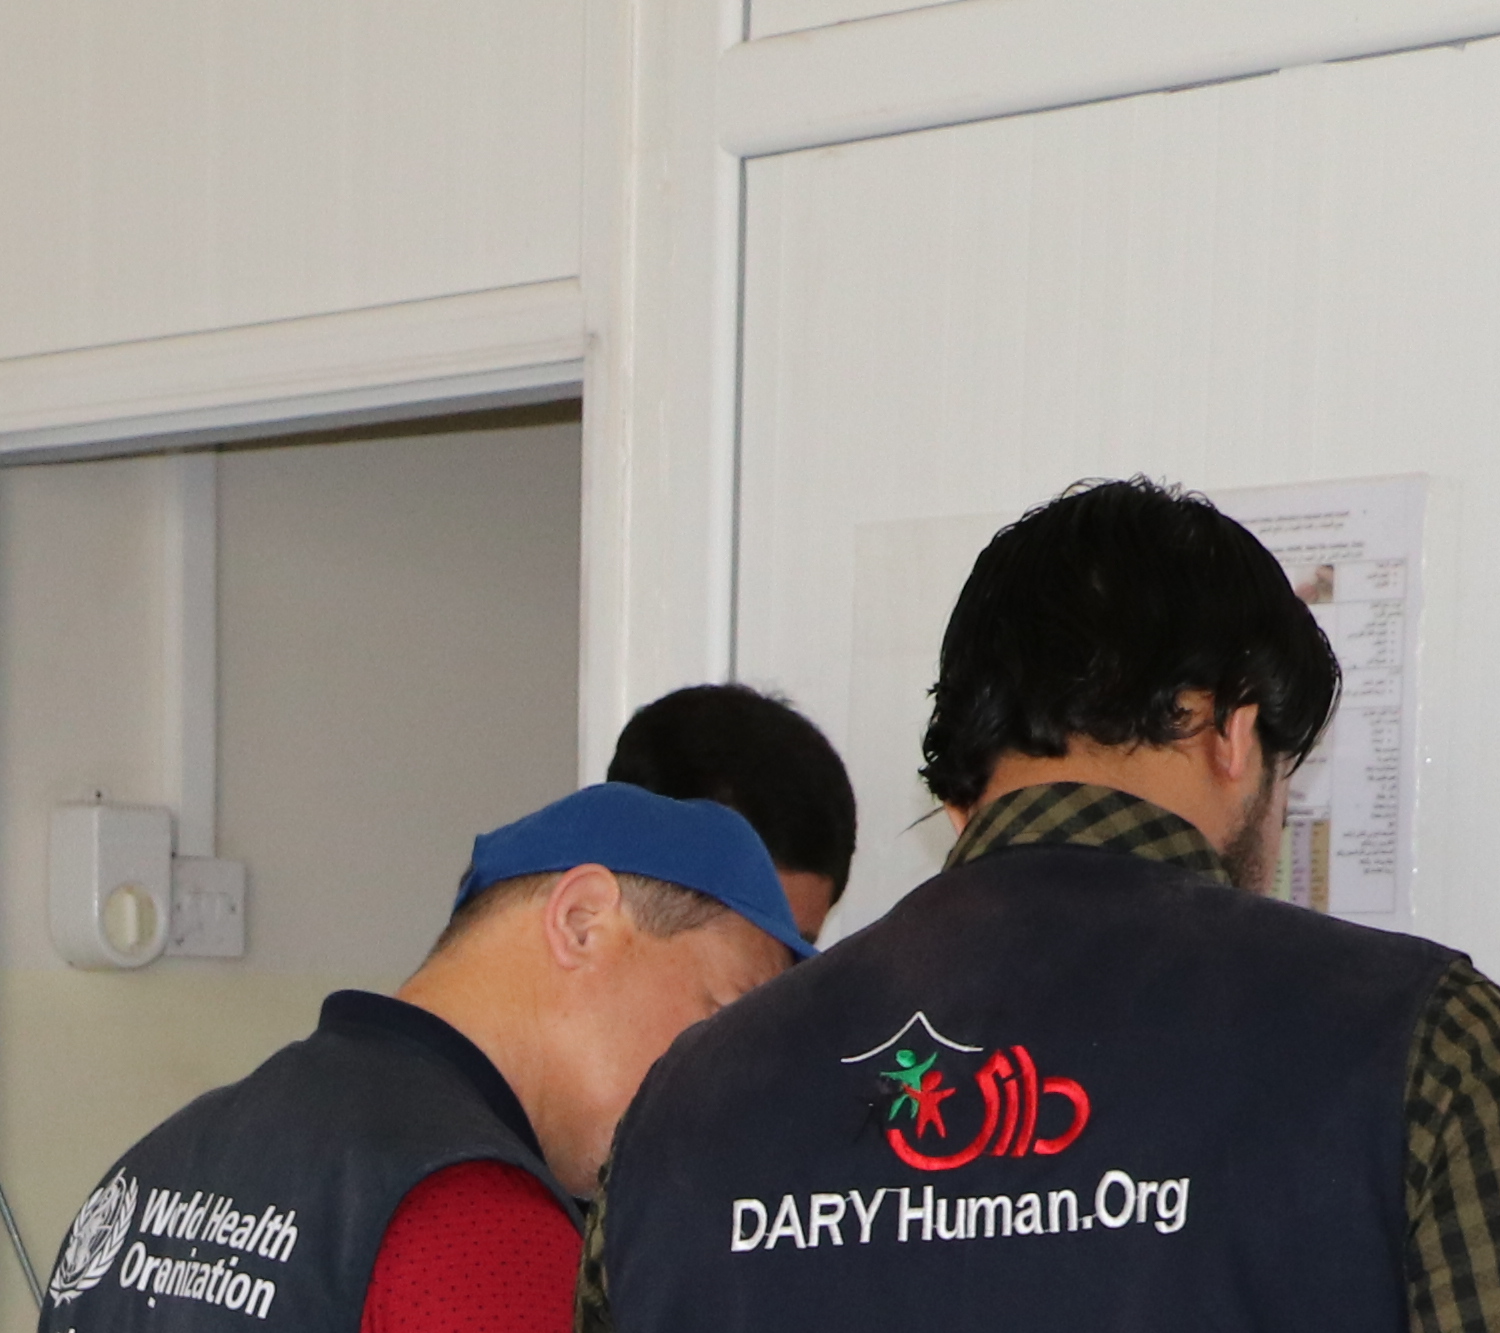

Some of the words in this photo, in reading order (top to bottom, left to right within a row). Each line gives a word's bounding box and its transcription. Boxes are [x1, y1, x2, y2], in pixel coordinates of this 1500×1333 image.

[201, 1196, 299, 1263] Health
[730, 1189, 888, 1253] DARY
[897, 1168, 1191, 1245] Human.Org
